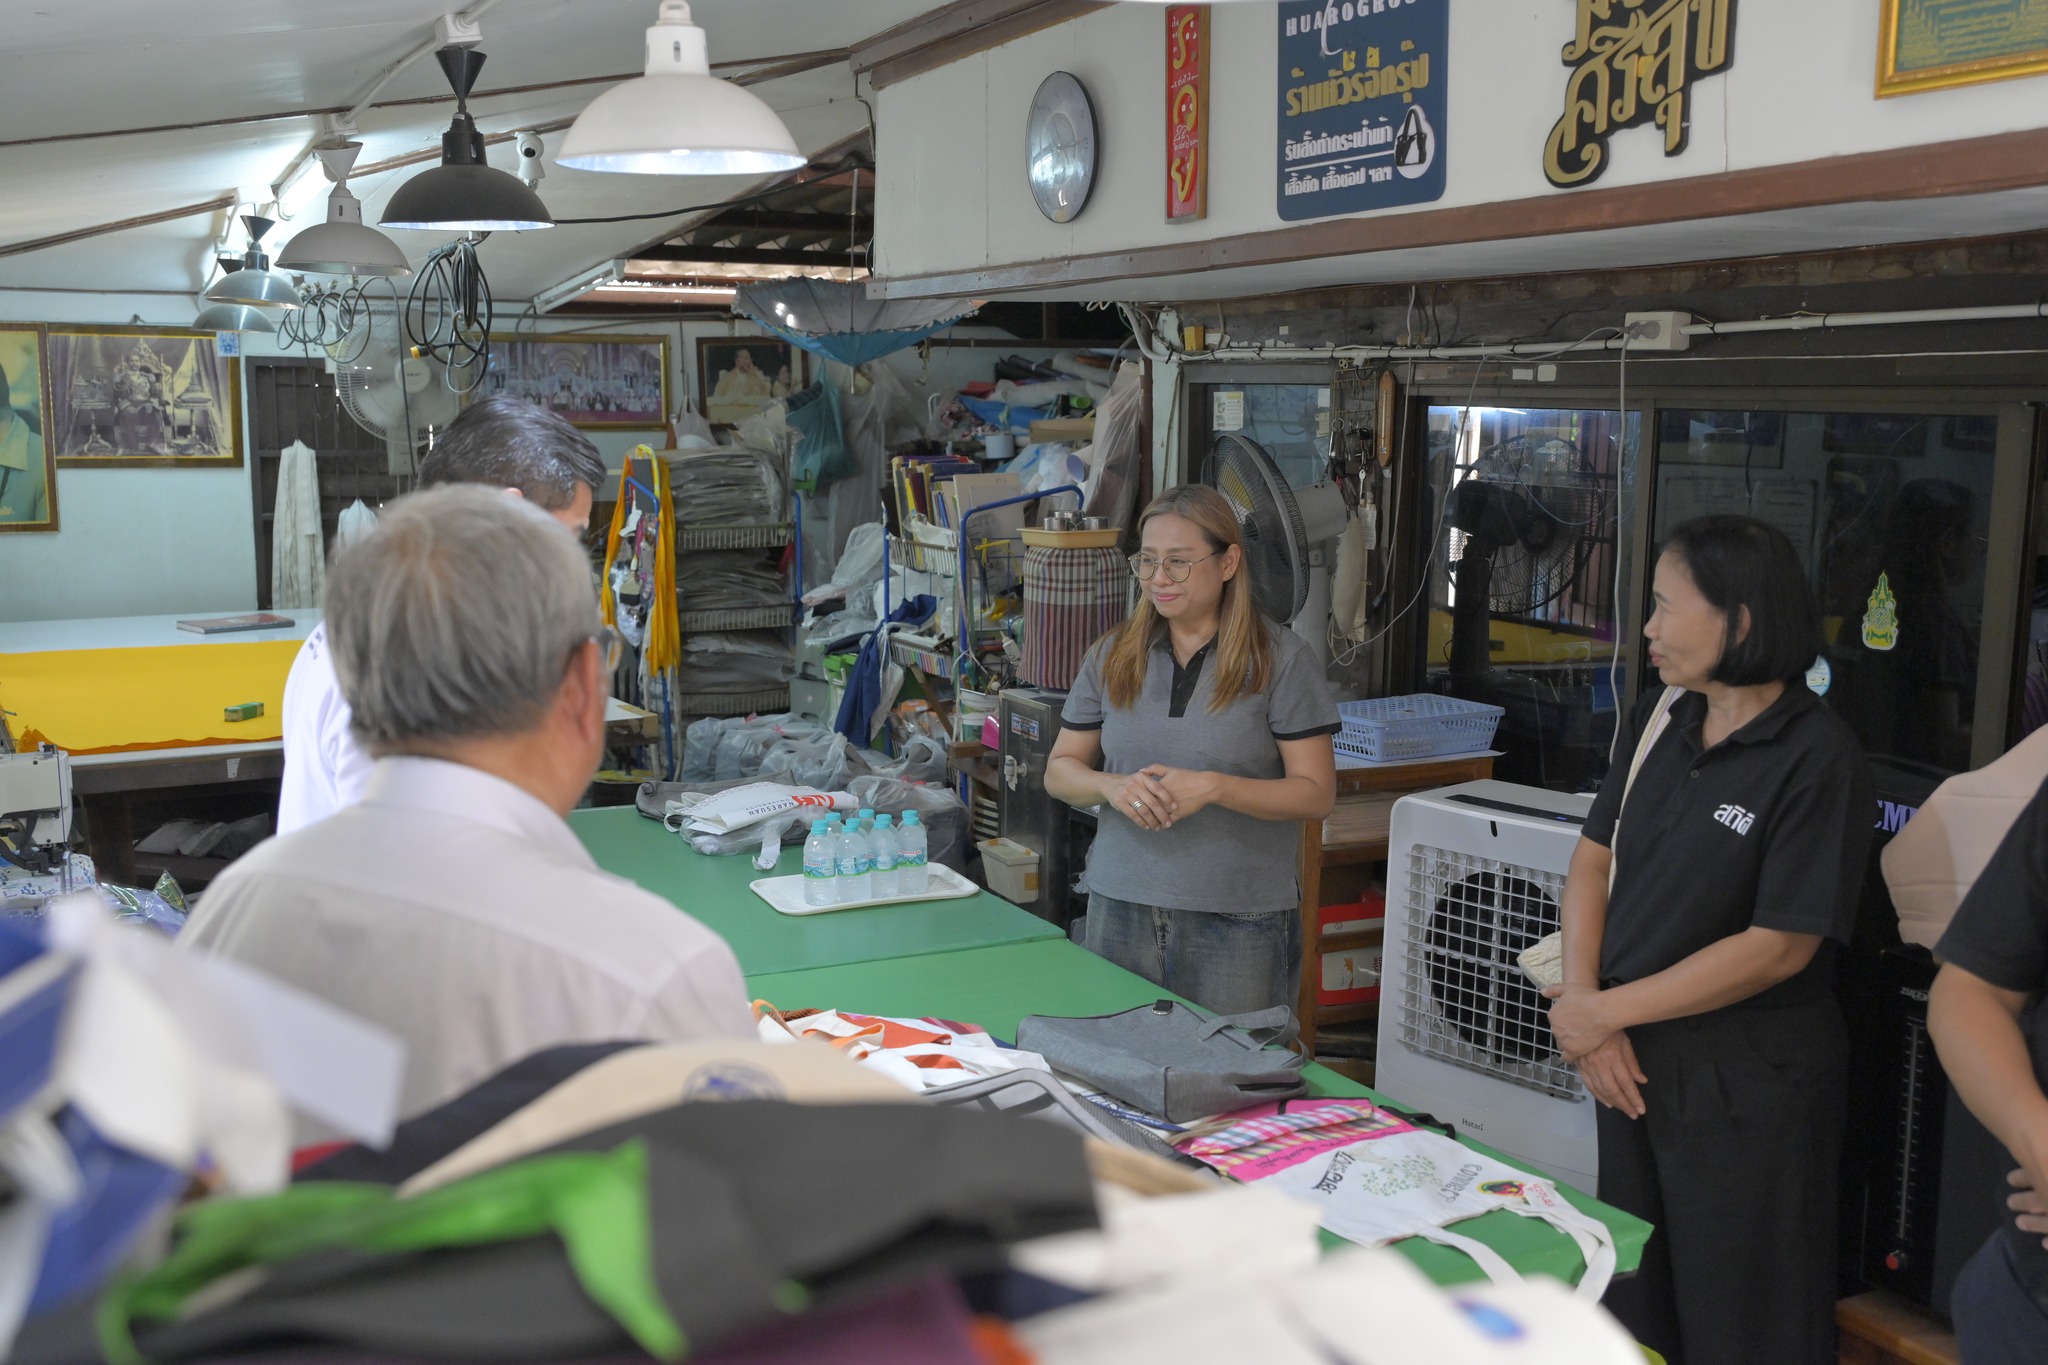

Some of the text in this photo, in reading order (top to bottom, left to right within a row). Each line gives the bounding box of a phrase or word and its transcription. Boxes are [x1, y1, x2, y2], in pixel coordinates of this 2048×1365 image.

[1285, 0, 1417, 37] HUAROGR
[748, 801, 795, 816] NARESUAN
[1462, 1118, 1484, 1131] Hatari
